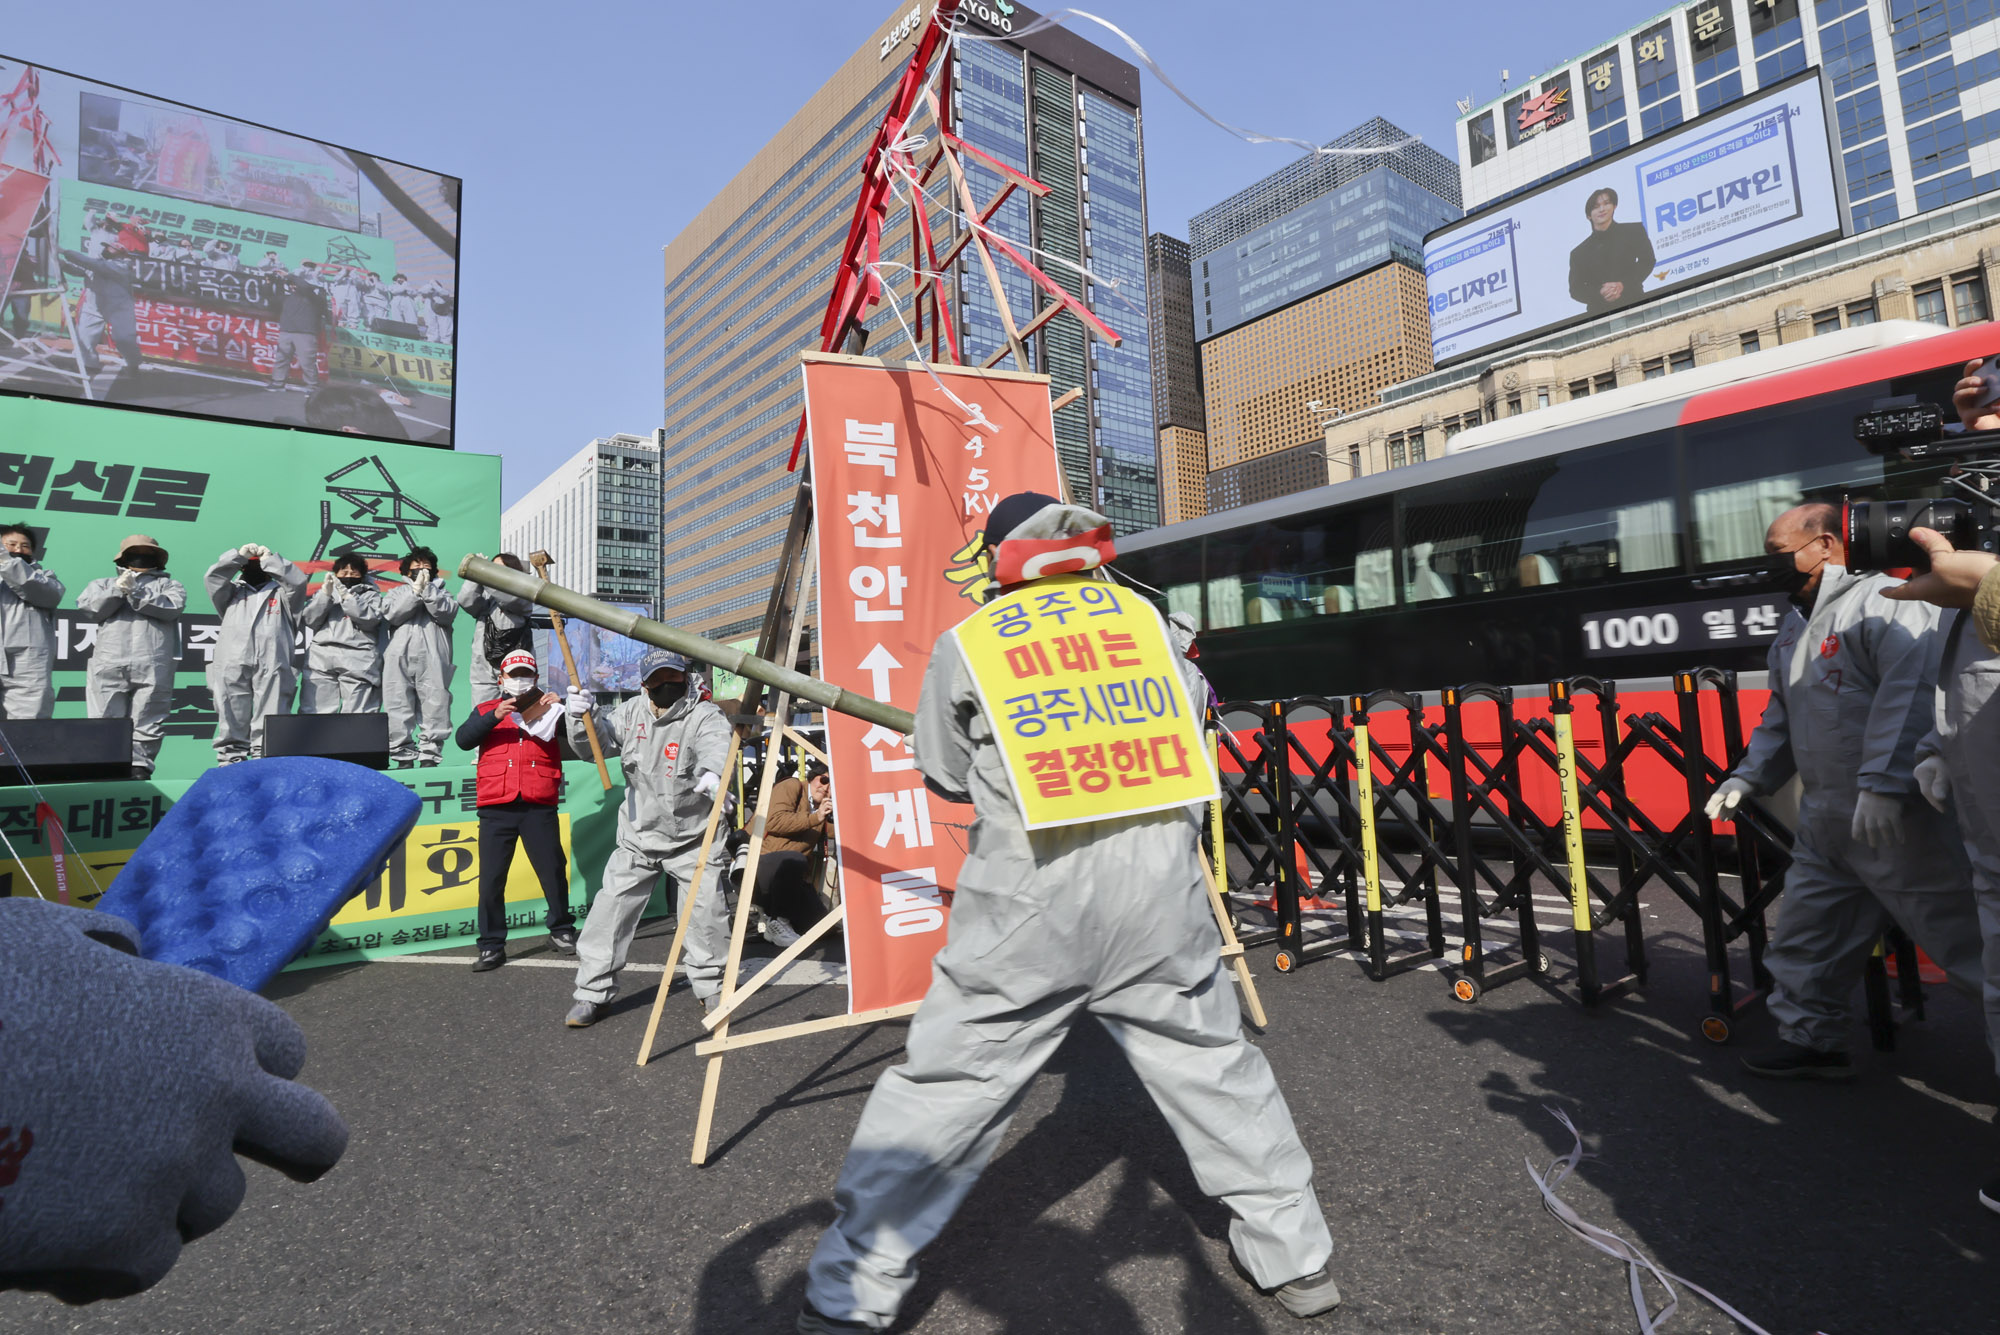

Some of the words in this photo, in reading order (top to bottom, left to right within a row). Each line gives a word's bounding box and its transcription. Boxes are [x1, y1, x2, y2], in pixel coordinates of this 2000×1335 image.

[880, 3, 921, 60] 교보생명
[959, 0, 1012, 33] KYOBO
[1519, 124, 1545, 141] KOREA
[1546, 112, 1568, 128] POST
[1674, 160, 1690, 174] 일상
[1692, 150, 1717, 166] 안전의
[1746, 128, 1772, 144] 높이다
[1655, 164, 1782, 232] Re디자인
[191, 218, 289, 249] 송전선로
[1670, 257, 1709, 275] 서울경찰청
[388, 340, 415, 354] 구성
[844, 419, 908, 623] 북천안
[963, 491, 1000, 516] KV
[989, 586, 1123, 638] 공주의
[1582, 612, 1679, 650] 1000
[1003, 628, 1142, 679] 미래는
[1003, 676, 1179, 738] 공주시민이
[1025, 733, 1192, 799] 결정한다
[404, 780, 478, 815] 구를
[1558, 752, 1575, 836] POLICE
[1567, 851, 1578, 908] LINE
[391, 924, 451, 947] 송전탑
[459, 919, 478, 936] 건
[505, 909, 536, 931] 반대
